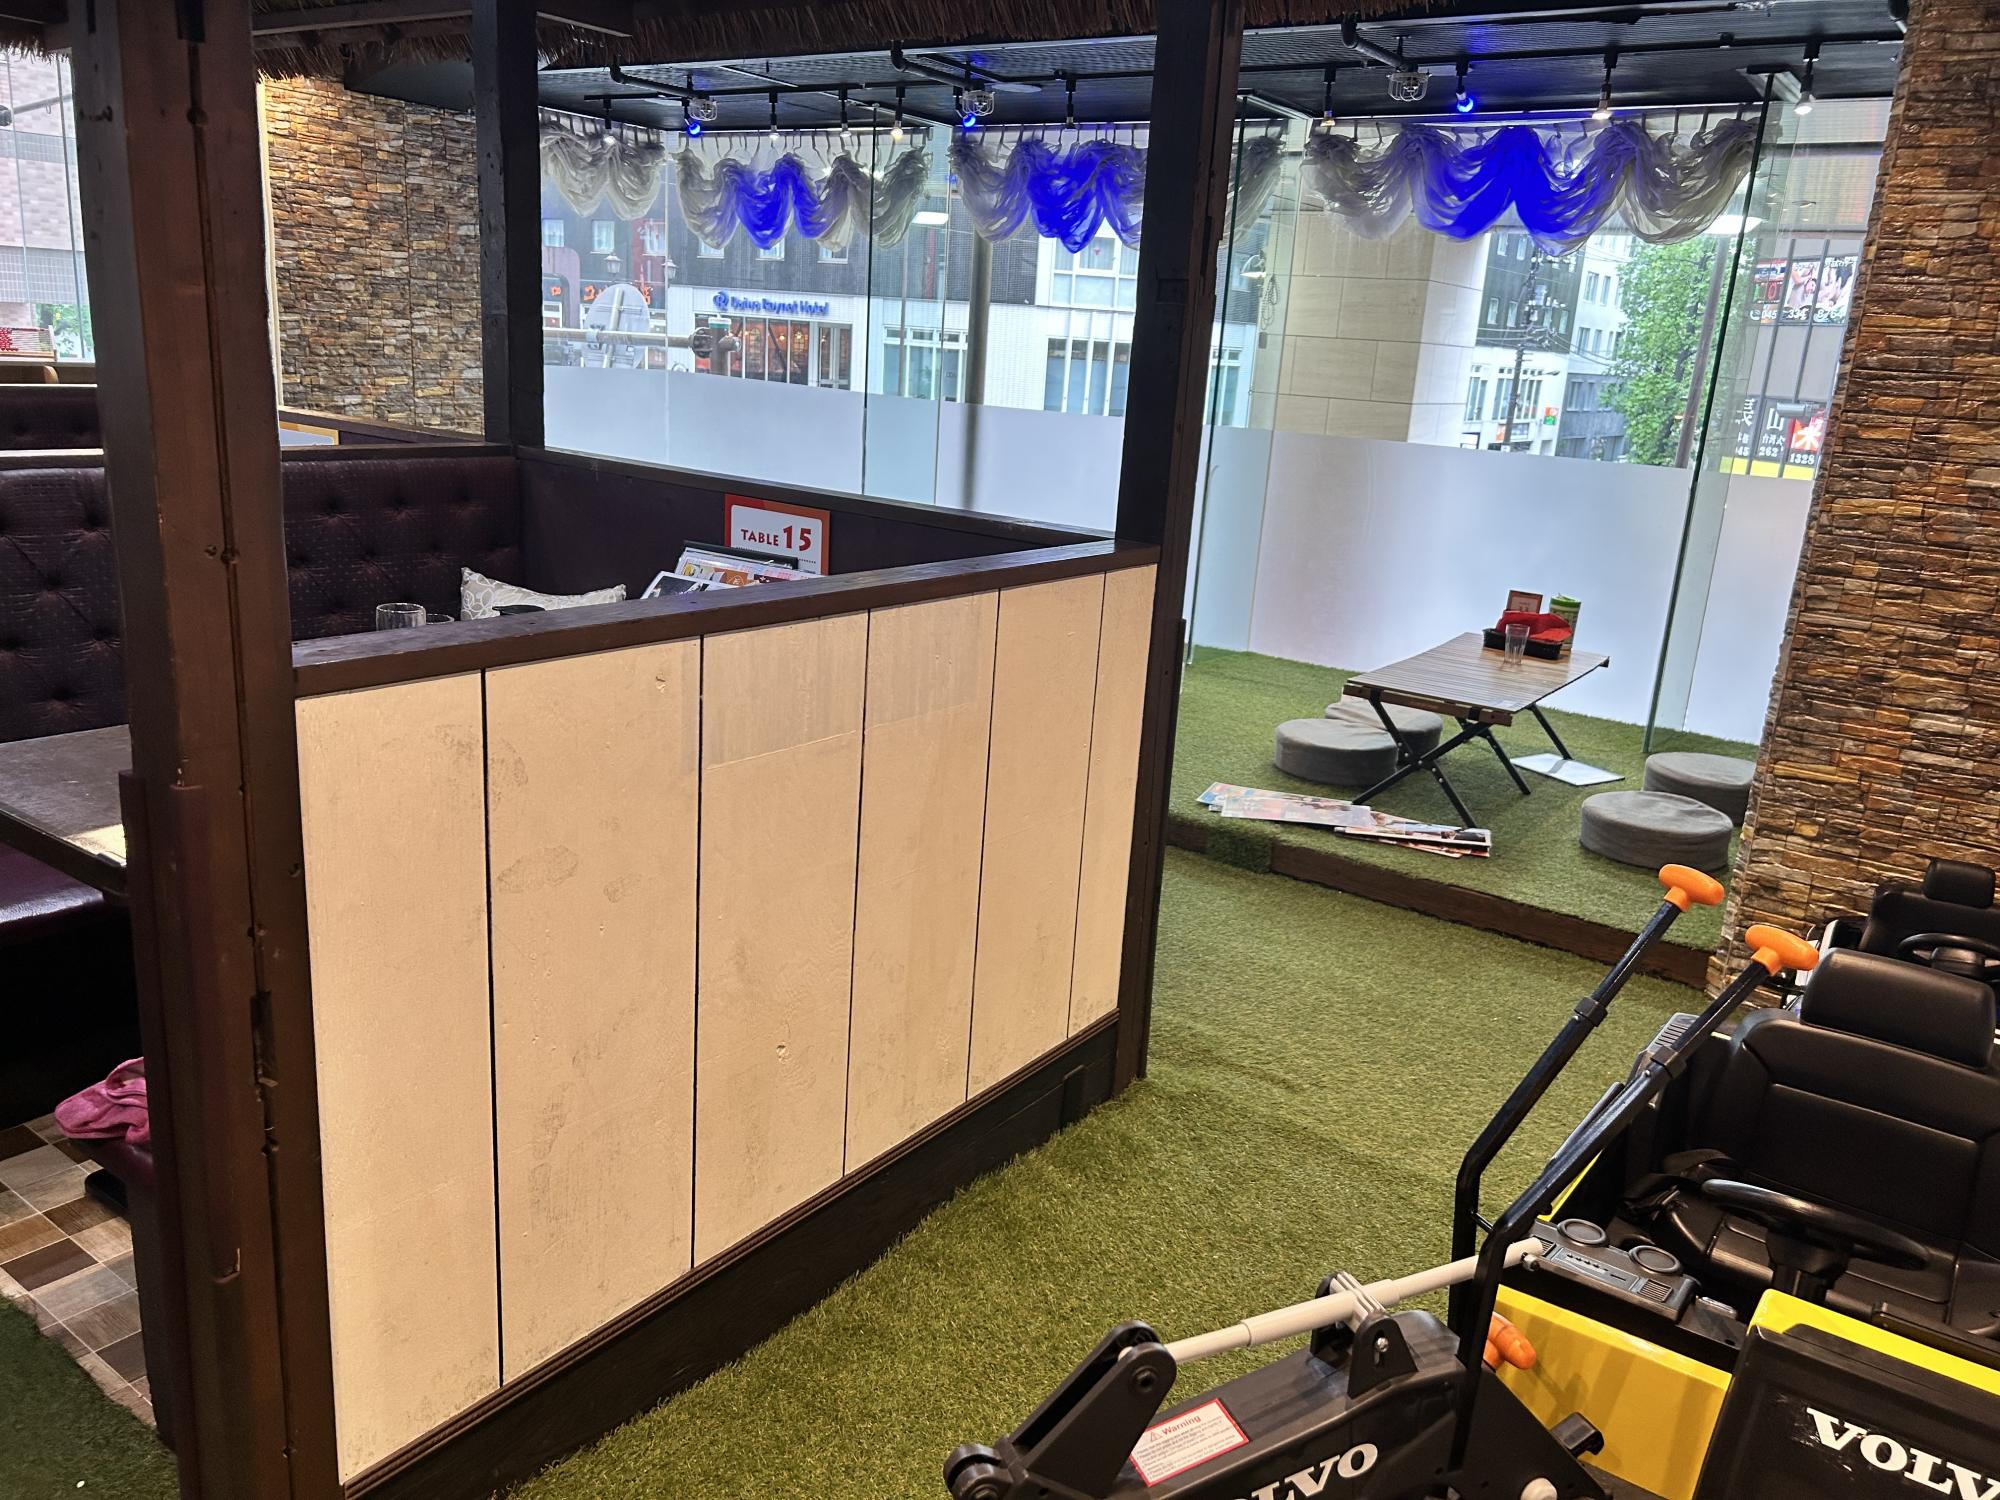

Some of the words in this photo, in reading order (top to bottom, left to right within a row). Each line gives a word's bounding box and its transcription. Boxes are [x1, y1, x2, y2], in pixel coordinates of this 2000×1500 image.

[740, 528, 779, 547] TABLE
[783, 525, 812, 552] 15
[1161, 1415, 1202, 1436] Warning
